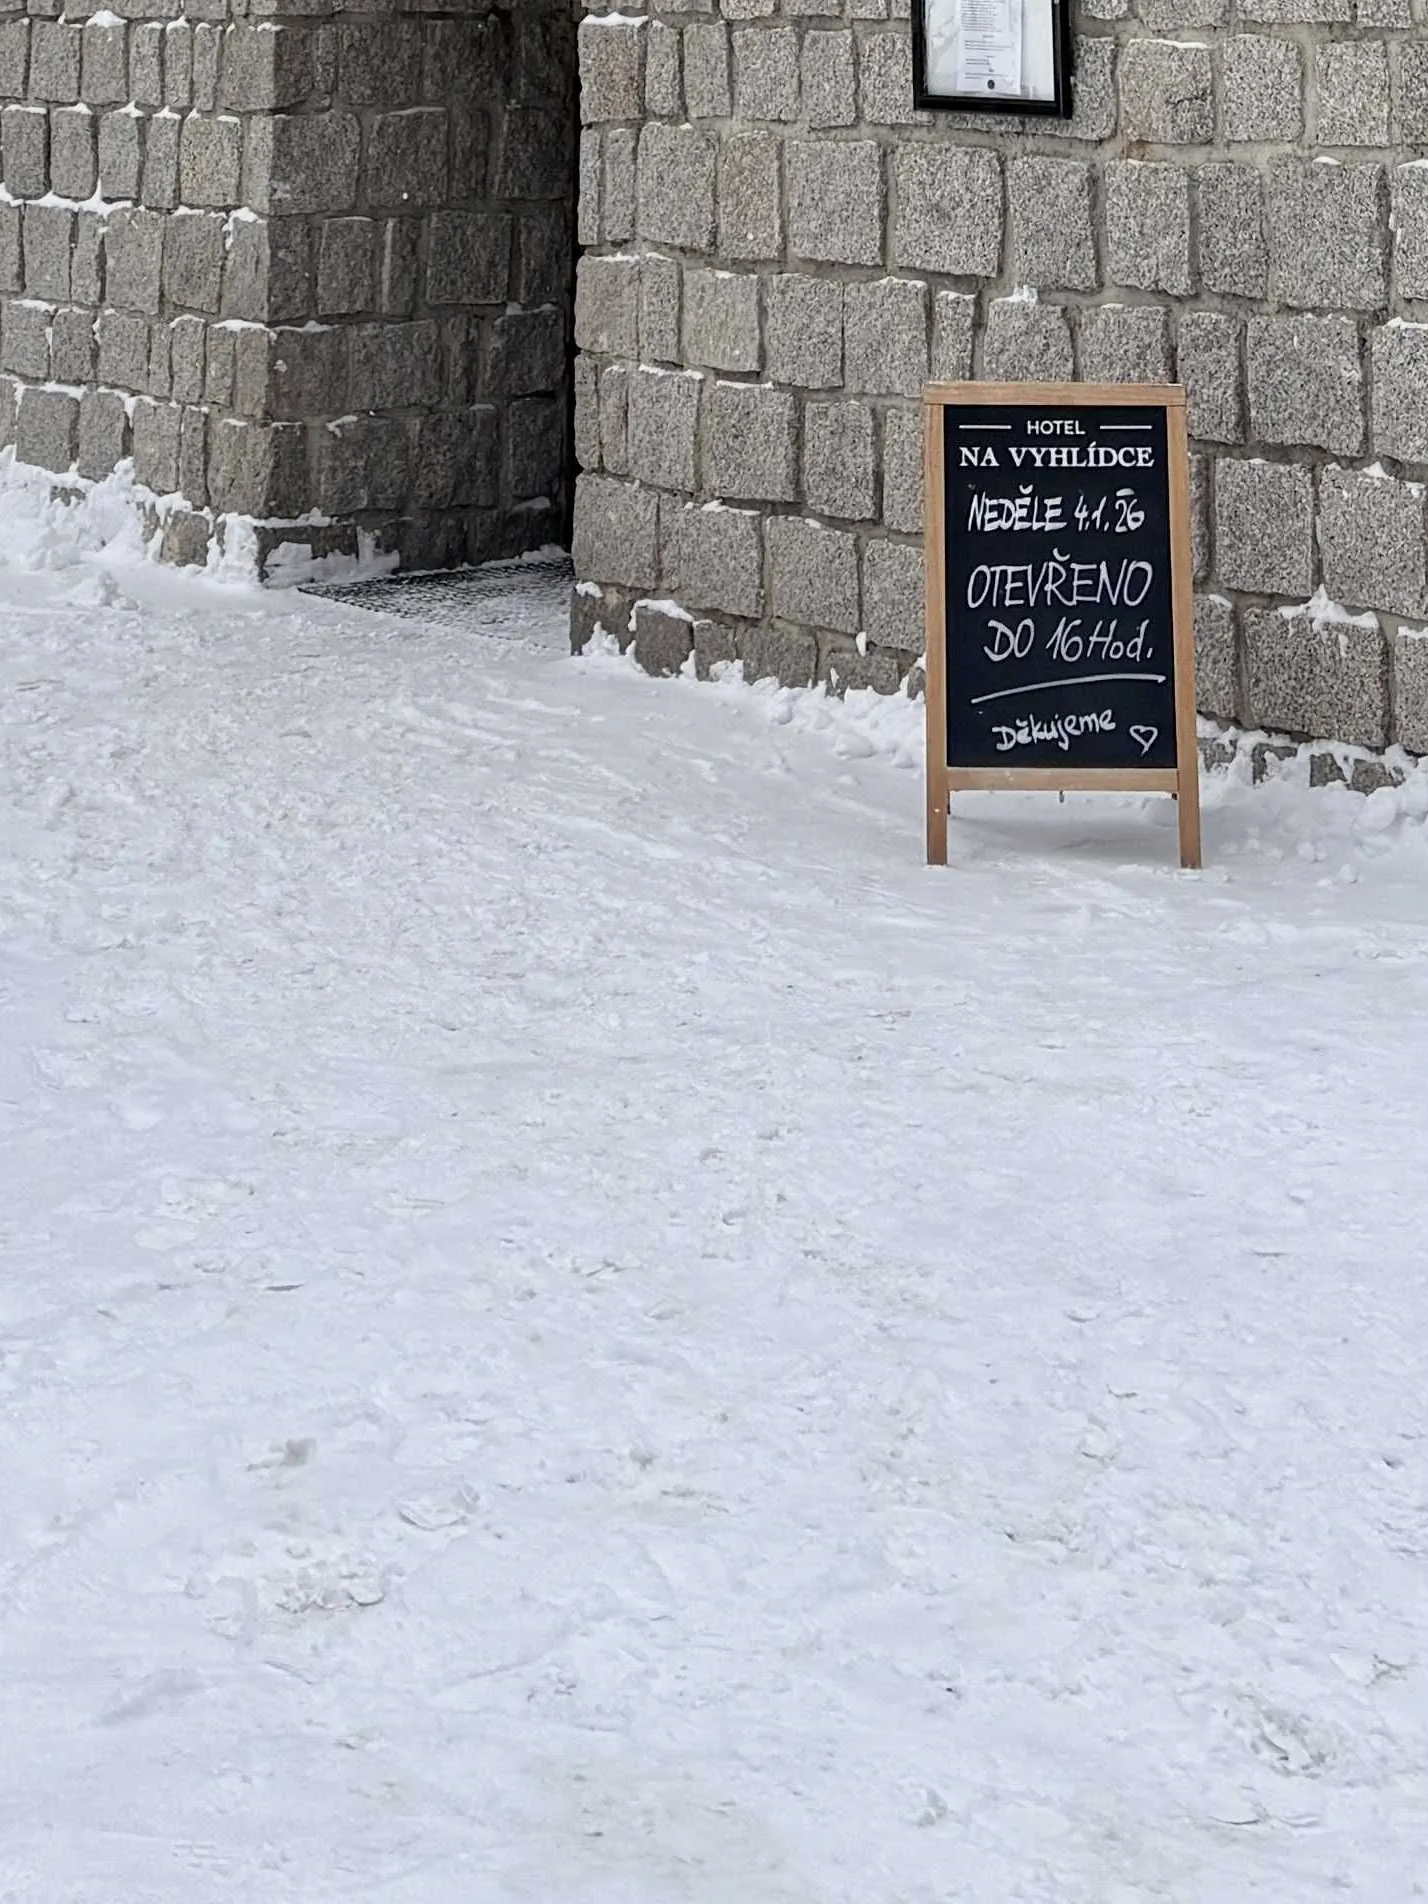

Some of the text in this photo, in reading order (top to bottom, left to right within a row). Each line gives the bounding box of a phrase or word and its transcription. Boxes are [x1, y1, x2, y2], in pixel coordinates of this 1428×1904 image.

[1027, 420, 1086, 435] HOTEL
[959, 441, 1155, 467] NA VYHLÍDCE
[968, 484, 1067, 532] NEDĚLE
[967, 547, 1153, 609] OTEVŘENO
[983, 618, 1035, 662] DO
[992, 709, 1116, 752] Děkujeme
